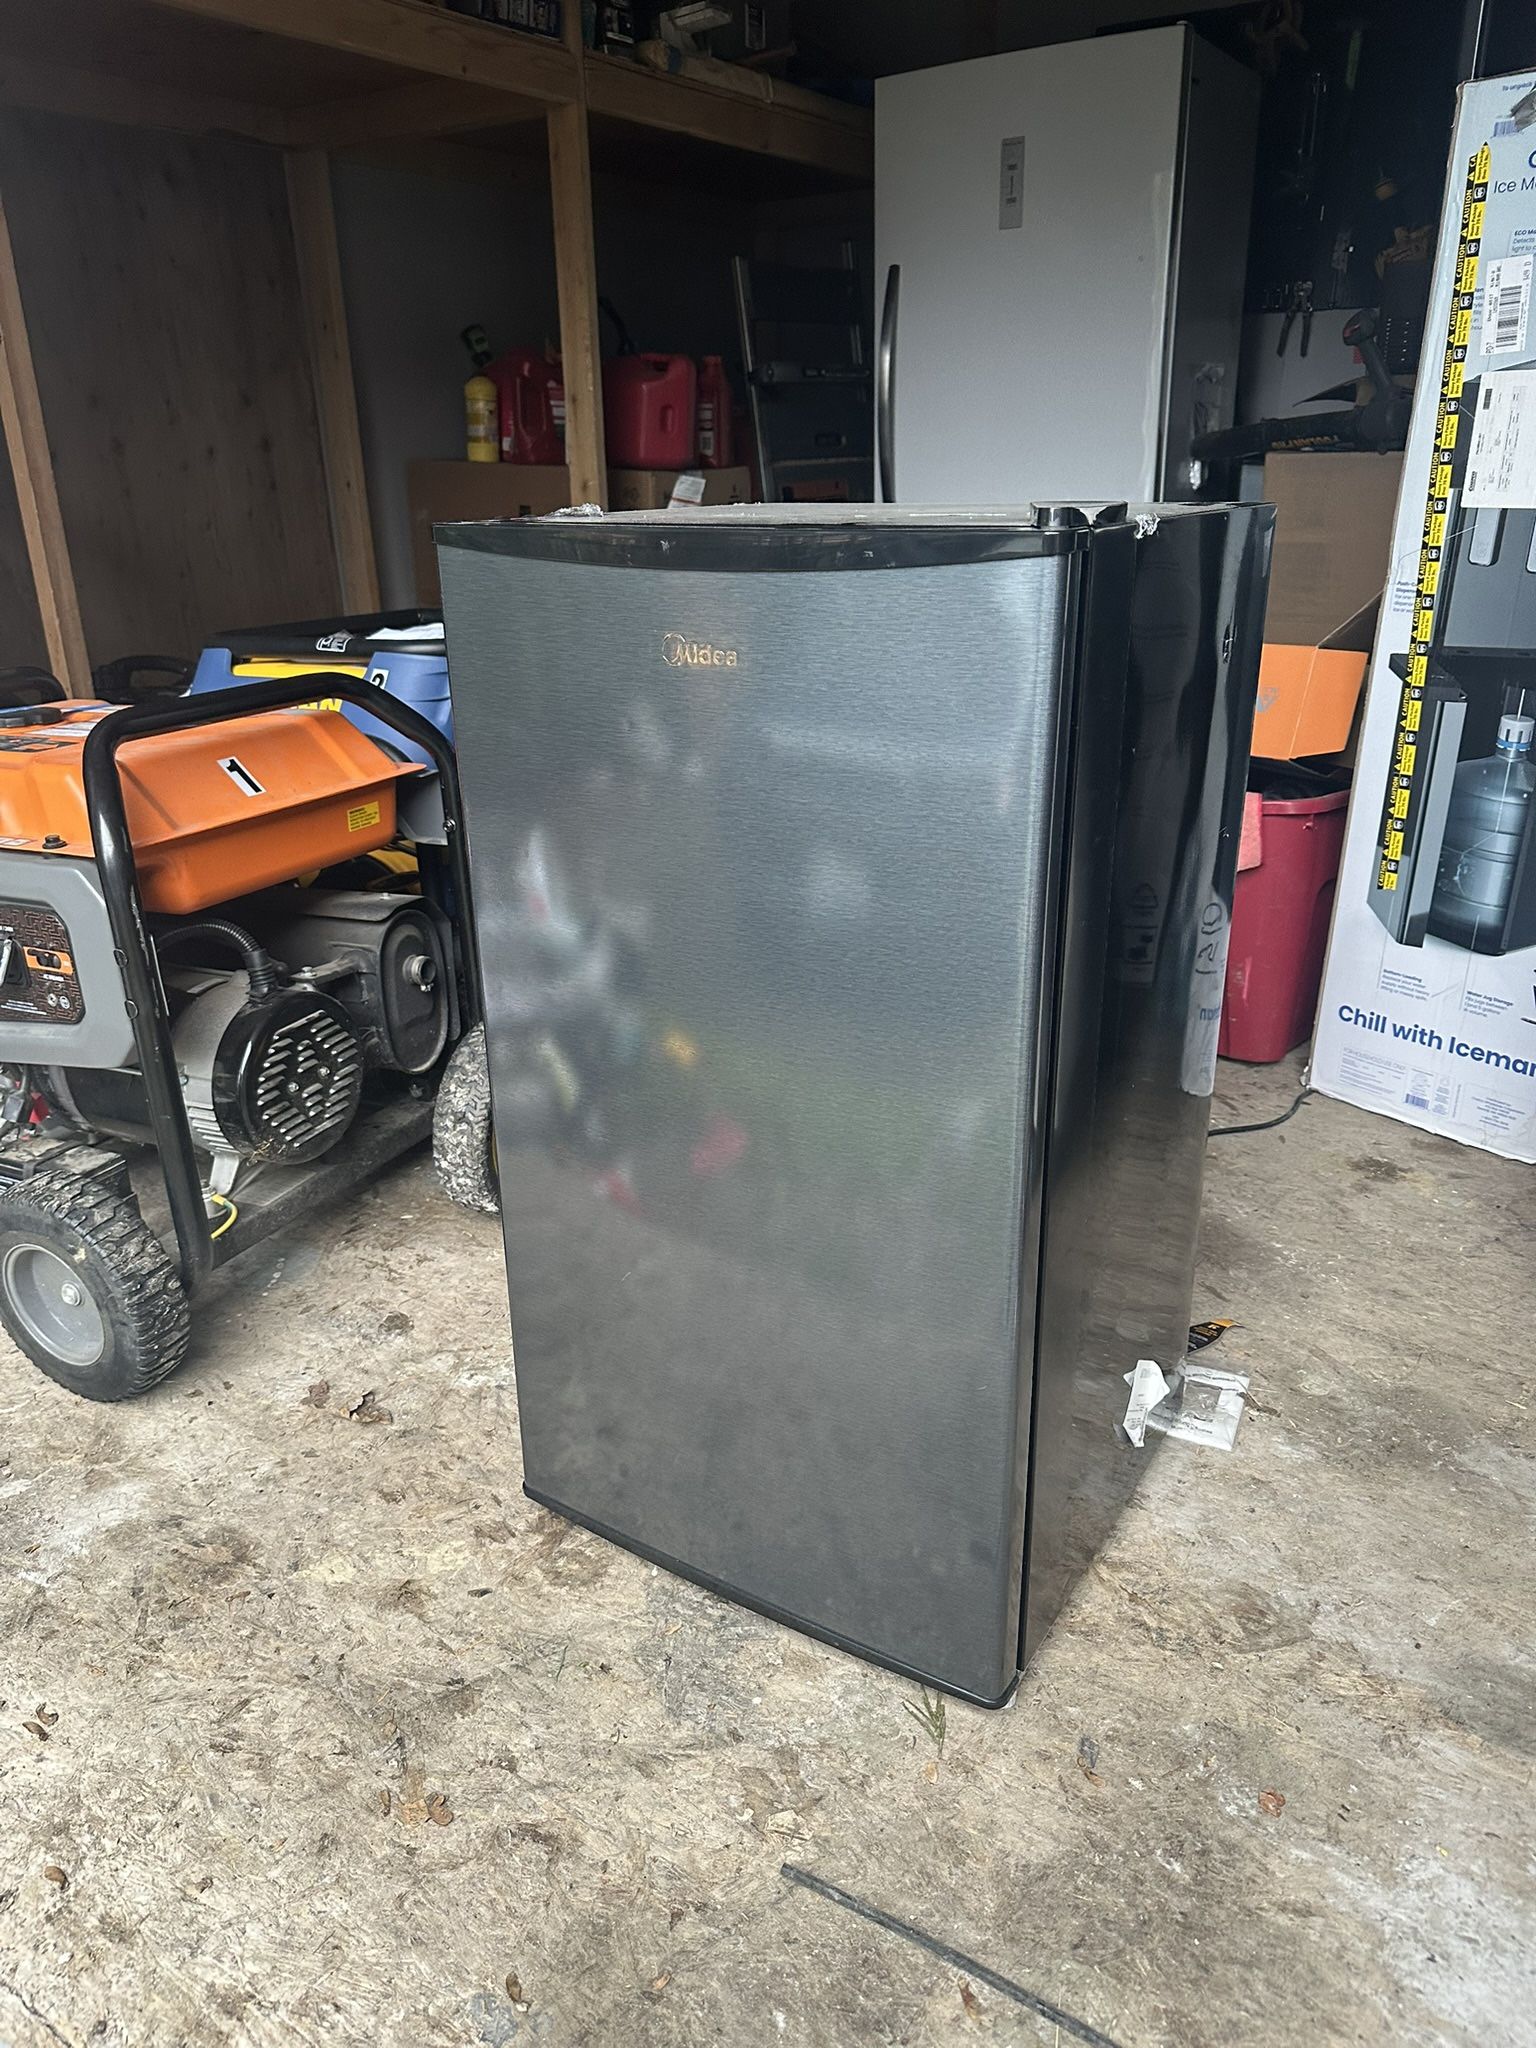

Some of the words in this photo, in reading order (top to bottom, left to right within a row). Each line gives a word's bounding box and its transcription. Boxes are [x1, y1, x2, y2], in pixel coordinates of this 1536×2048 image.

[1494, 180, 1516, 194] Ice
[1463, 189, 1472, 224] CAUTION
[1456, 244, 1466, 278] CAUTION
[1450, 297, 1459, 330] CAUTION
[1444, 350, 1453, 381] CAUTION
[1436, 402, 1446, 433] CAUTION
[1430, 452, 1439, 484] CAUTION
[1424, 501, 1434, 531] CAUTION
[1418, 549, 1428, 579] CAUTION
[1413, 597, 1422, 626] CAUTION
[662, 632, 737, 666] Midea
[1407, 643, 1416, 672] CAUTION
[1401, 688, 1410, 716] CAUTION
[1396, 732, 1405, 760] CAUTION
[226, 758, 262, 793] 1
[1390, 776, 1398, 803] CAUTION
[1384, 819, 1392, 845] CAUTION
[1378, 860, 1387, 886] CAUTION
[1338, 1005, 1387, 1034] Chill
[1392, 1024, 1443, 1051] with
